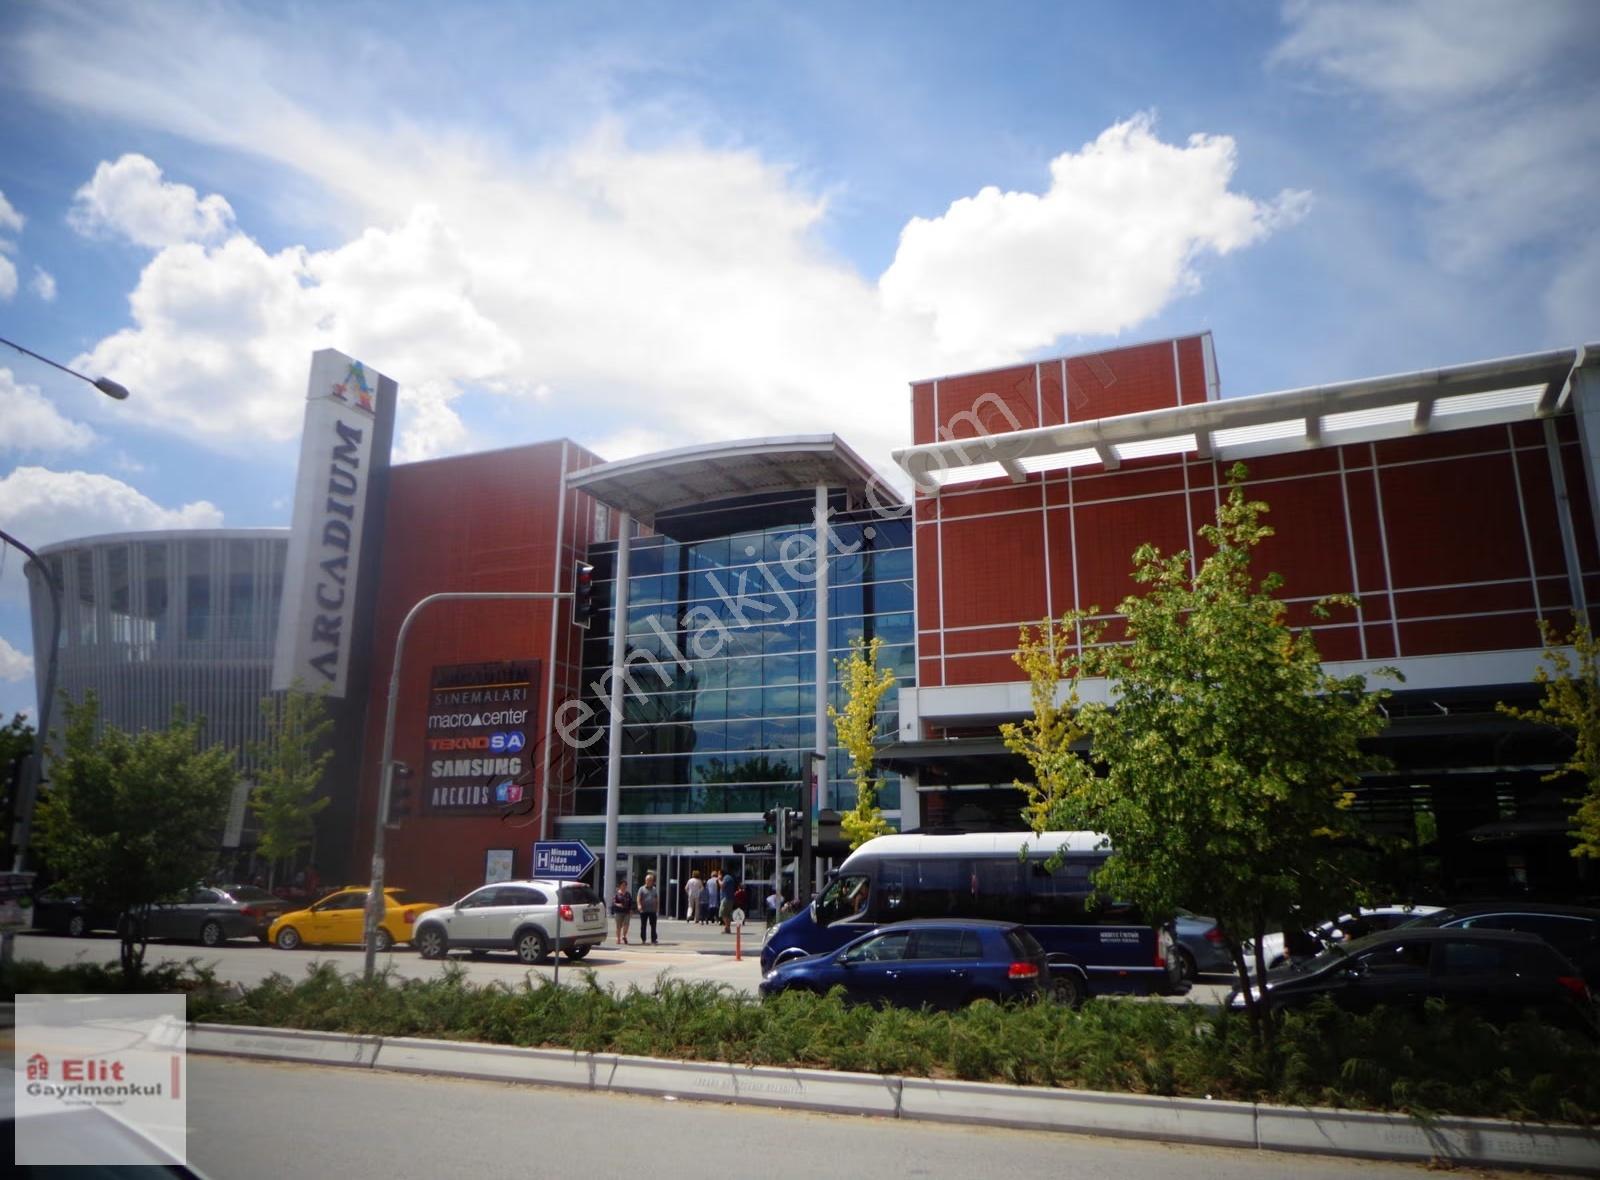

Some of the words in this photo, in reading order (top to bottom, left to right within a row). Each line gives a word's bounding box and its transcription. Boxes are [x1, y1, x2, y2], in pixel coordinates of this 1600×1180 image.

[308, 419, 363, 682] ARCADIUM
[432, 757, 522, 777] SAMSUNG
[538, 852, 548, 868] H
